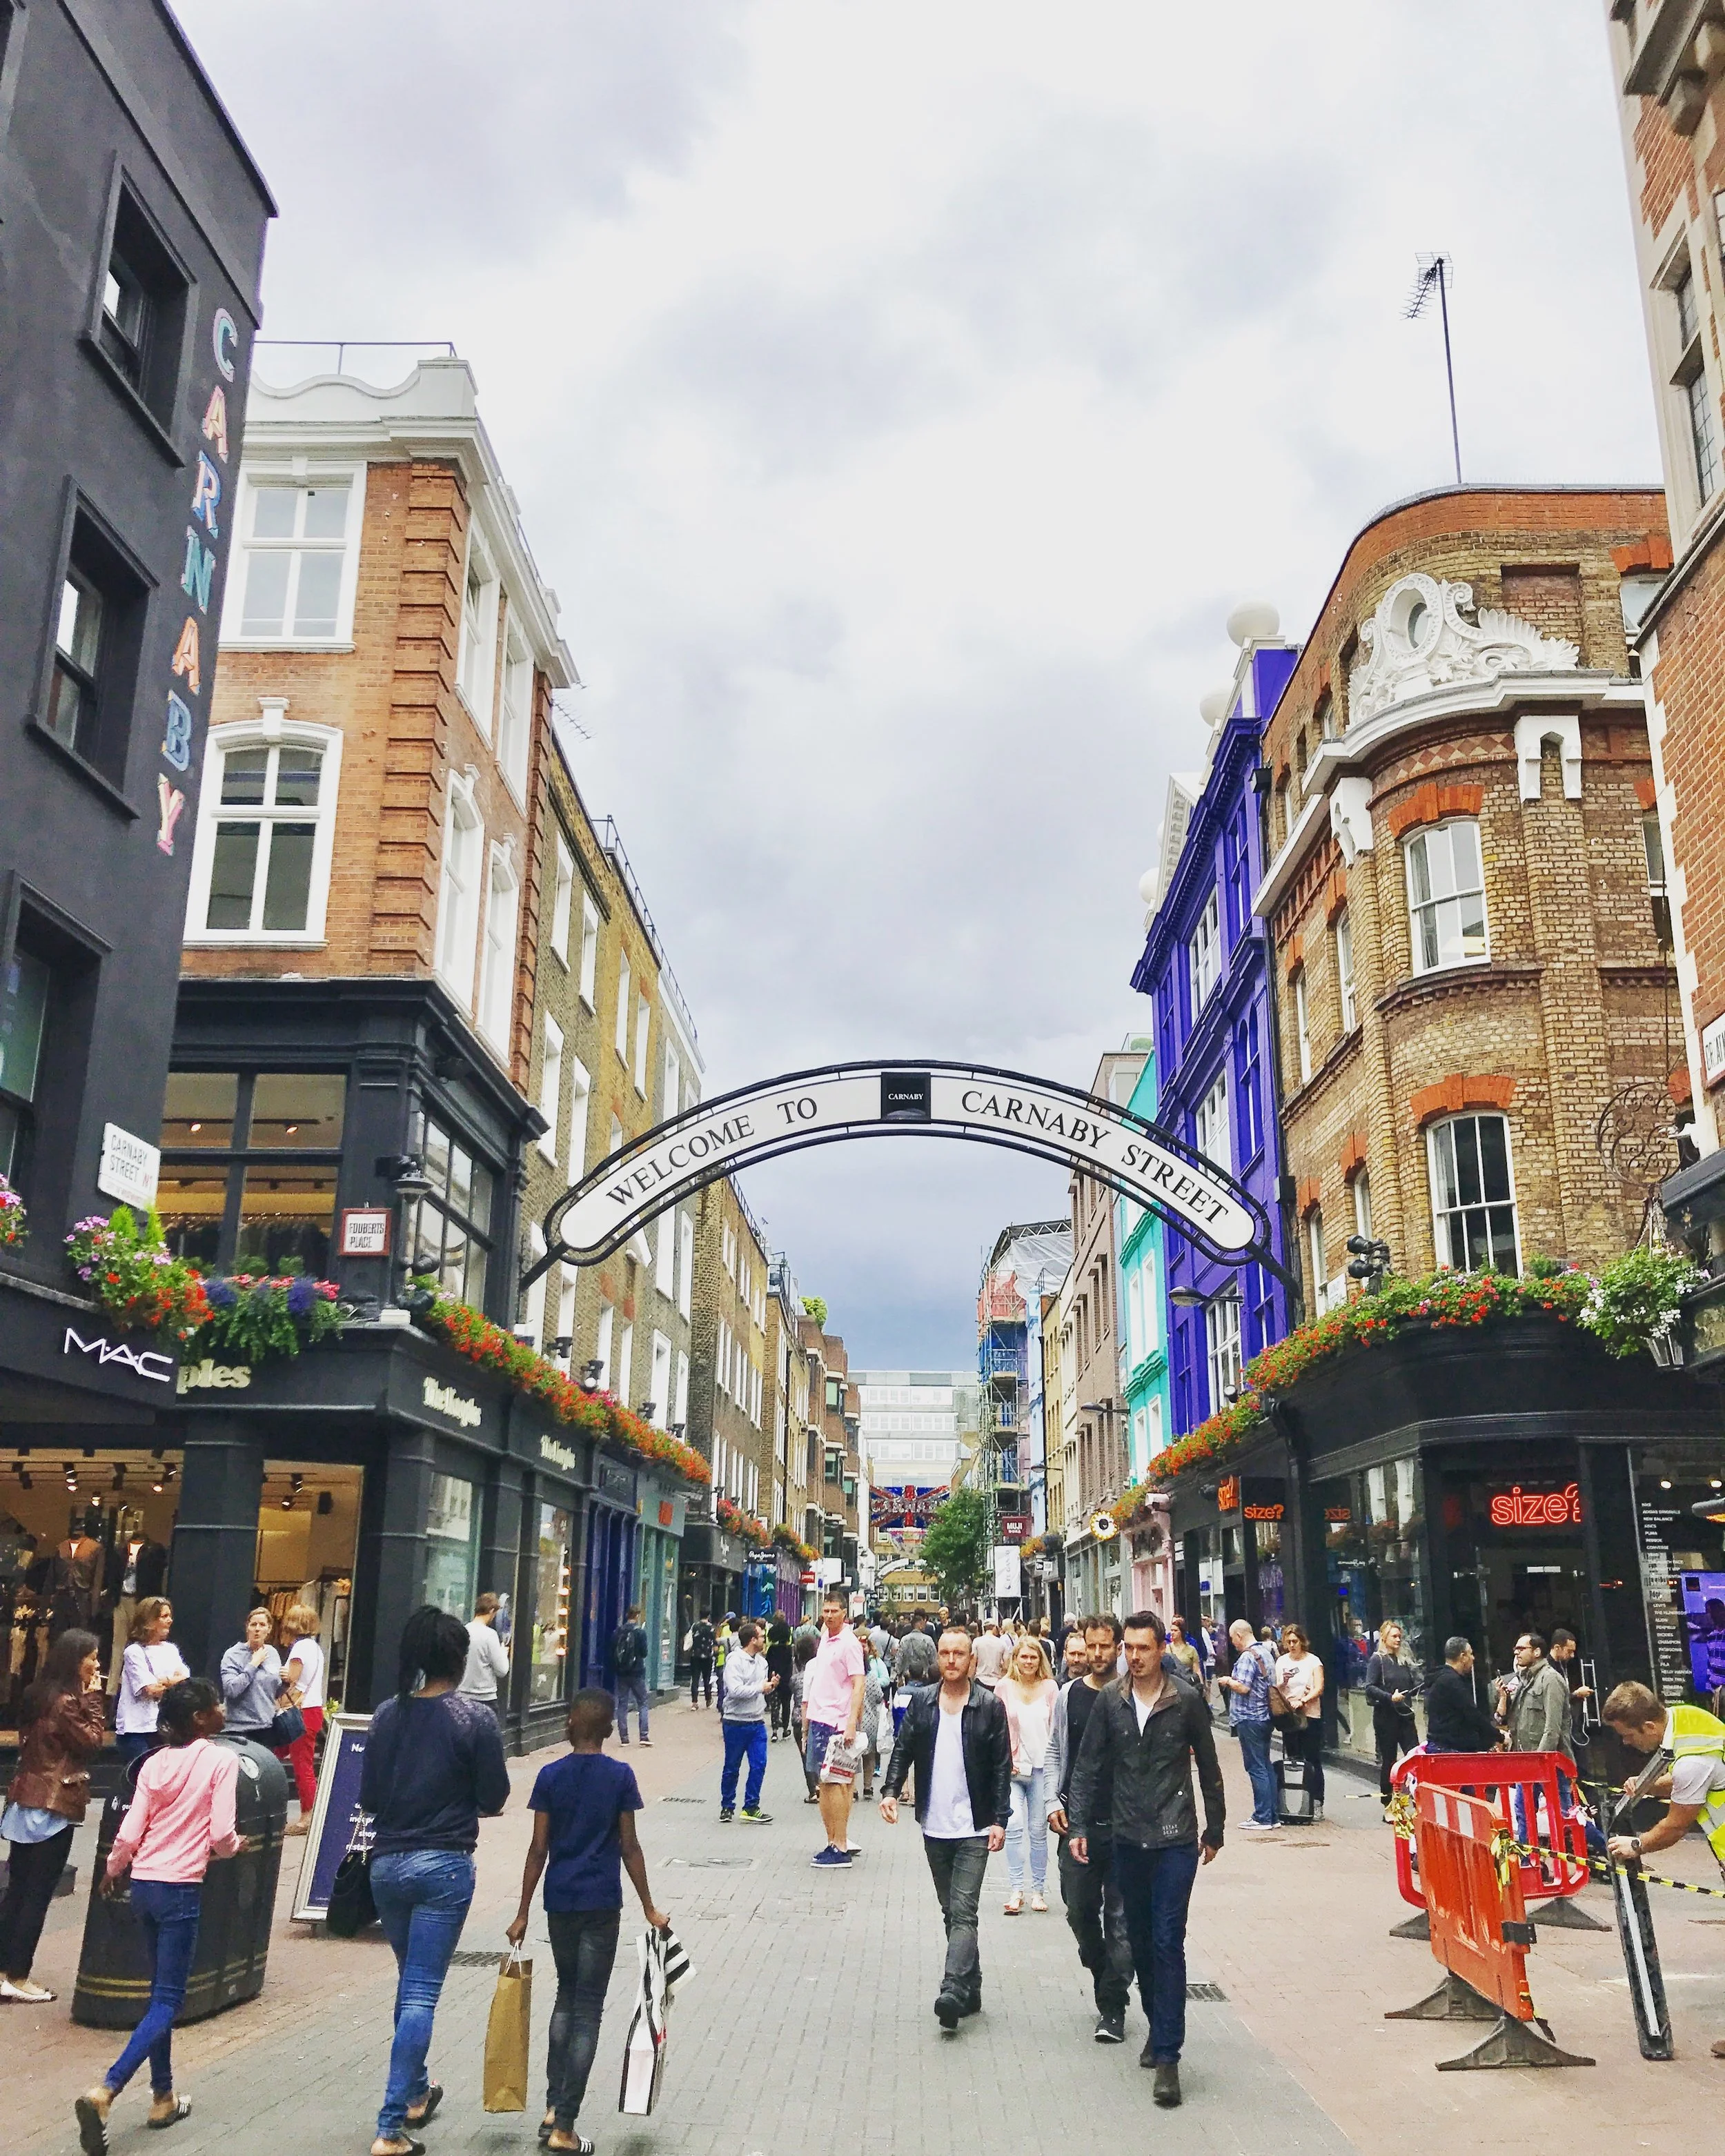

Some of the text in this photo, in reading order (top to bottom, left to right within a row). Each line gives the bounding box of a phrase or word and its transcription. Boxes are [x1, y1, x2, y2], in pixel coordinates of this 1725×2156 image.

[157, 307, 237, 856] CARNABY
[111, 1134, 147, 1167] CARNABY
[606, 1090, 1228, 1225] WELCOME TO CARNABY STREET
[110, 1154, 139, 1183] STREET
[350, 1236, 373, 1248] PLACE
[1244, 1503, 1285, 1520] size?
